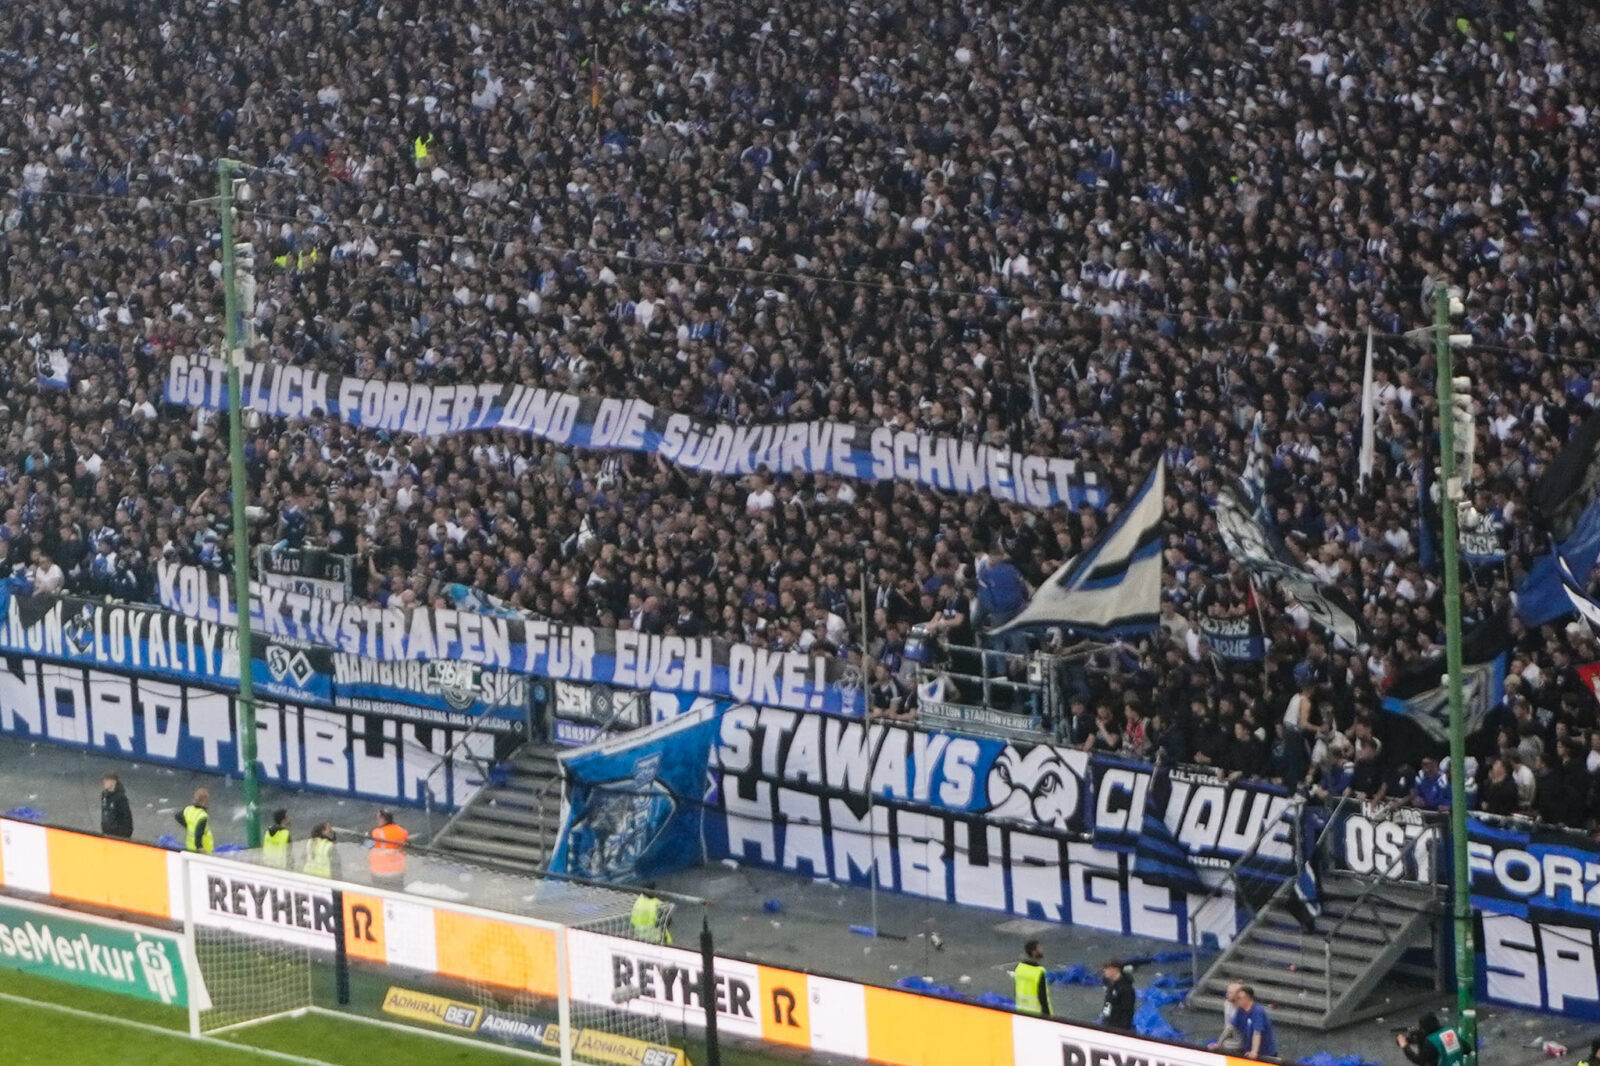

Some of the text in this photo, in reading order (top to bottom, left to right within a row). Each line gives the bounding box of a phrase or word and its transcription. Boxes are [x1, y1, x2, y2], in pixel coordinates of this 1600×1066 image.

[170, 354, 328, 418] GÖTTLICH
[339, 377, 503, 434] FORDERT
[499, 383, 580, 444] UND
[591, 397, 654, 447] DIE
[659, 413, 856, 475] SÜDKURVE
[95, 606, 218, 676] LOYALTY
[157, 560, 511, 669] KOLLEKTIVSTRAFEN
[524, 620, 596, 679] FÜR
[613, 629, 712, 692] EUCH
[730, 643, 826, 709] OKE!
[480, 669, 524, 707] SÜD
[0, 657, 496, 808] NORDTRIBÜNE
[207, 874, 336, 934] REYHER
[611, 954, 754, 1018] REYHER
[1482, 910, 1600, 1010] SP
